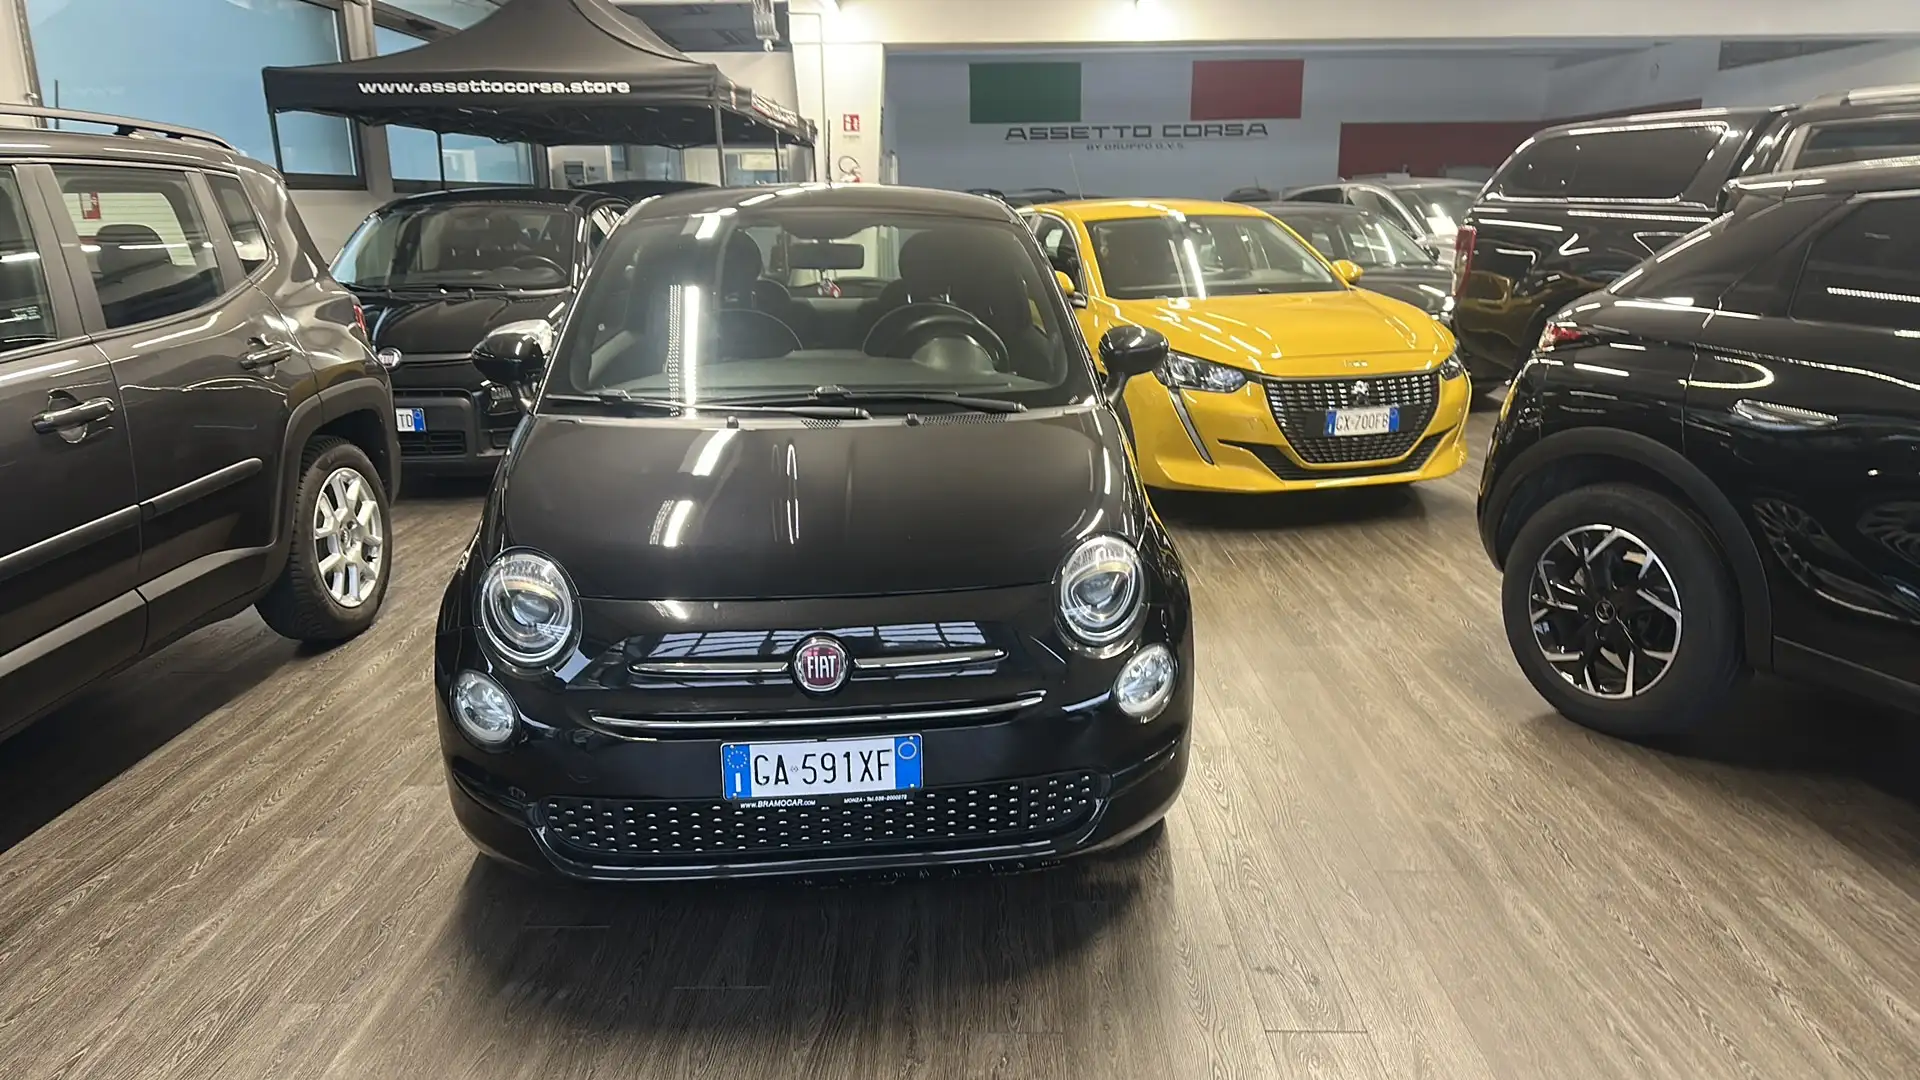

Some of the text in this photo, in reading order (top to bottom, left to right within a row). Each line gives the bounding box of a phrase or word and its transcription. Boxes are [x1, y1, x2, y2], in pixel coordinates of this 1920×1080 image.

[358, 80, 631, 95] www.assettocorsa.store
[1005, 123, 1269, 141] ASSETTO CORSA
[807, 655, 837, 679] FIAT
[753, 749, 893, 786] GA 591XF
